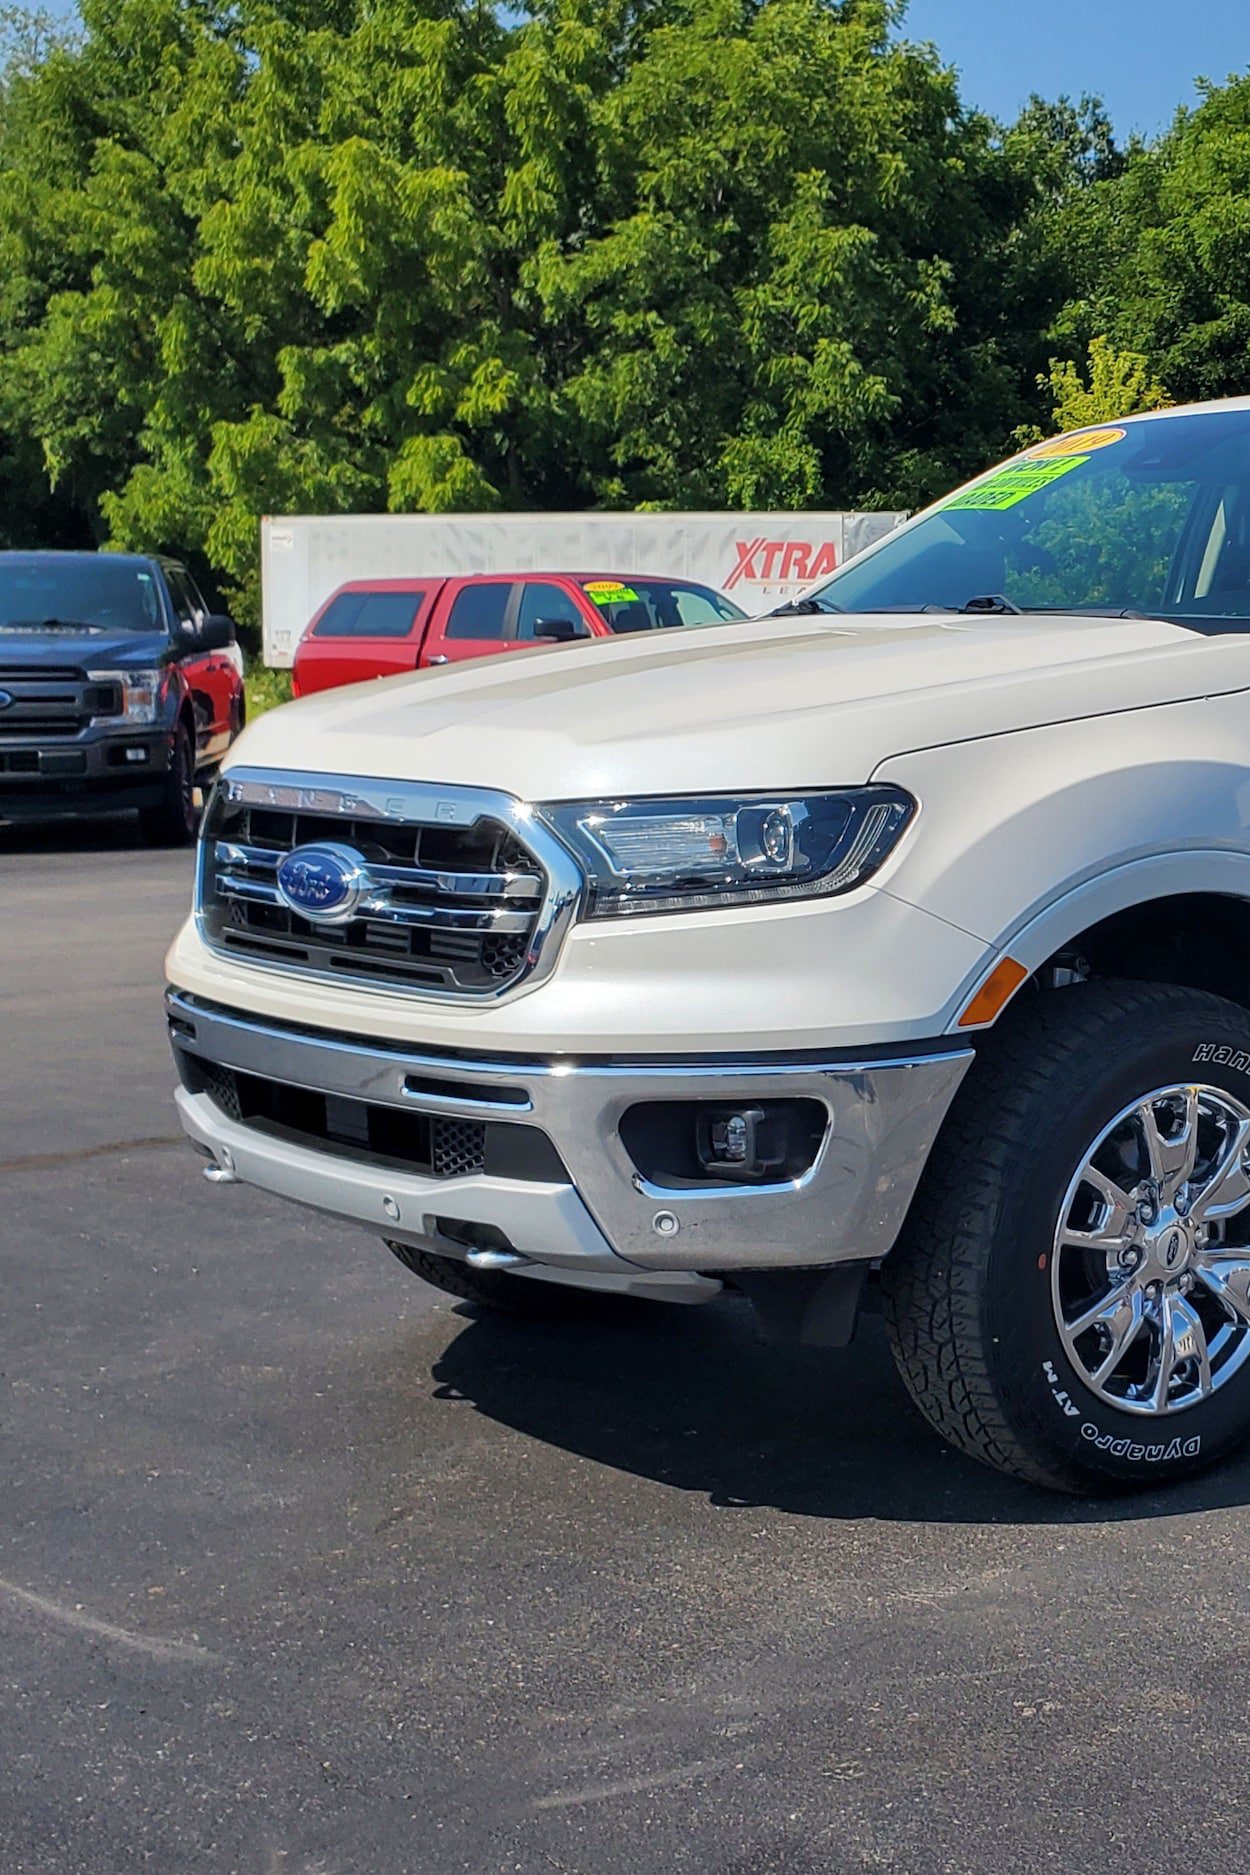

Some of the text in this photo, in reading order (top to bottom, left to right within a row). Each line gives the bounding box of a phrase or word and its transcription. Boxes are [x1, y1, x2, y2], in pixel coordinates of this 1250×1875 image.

[722, 538, 839, 589] XTRA
[283, 861, 333, 899] Ford
[1081, 1422, 1201, 1461] Dynapro
